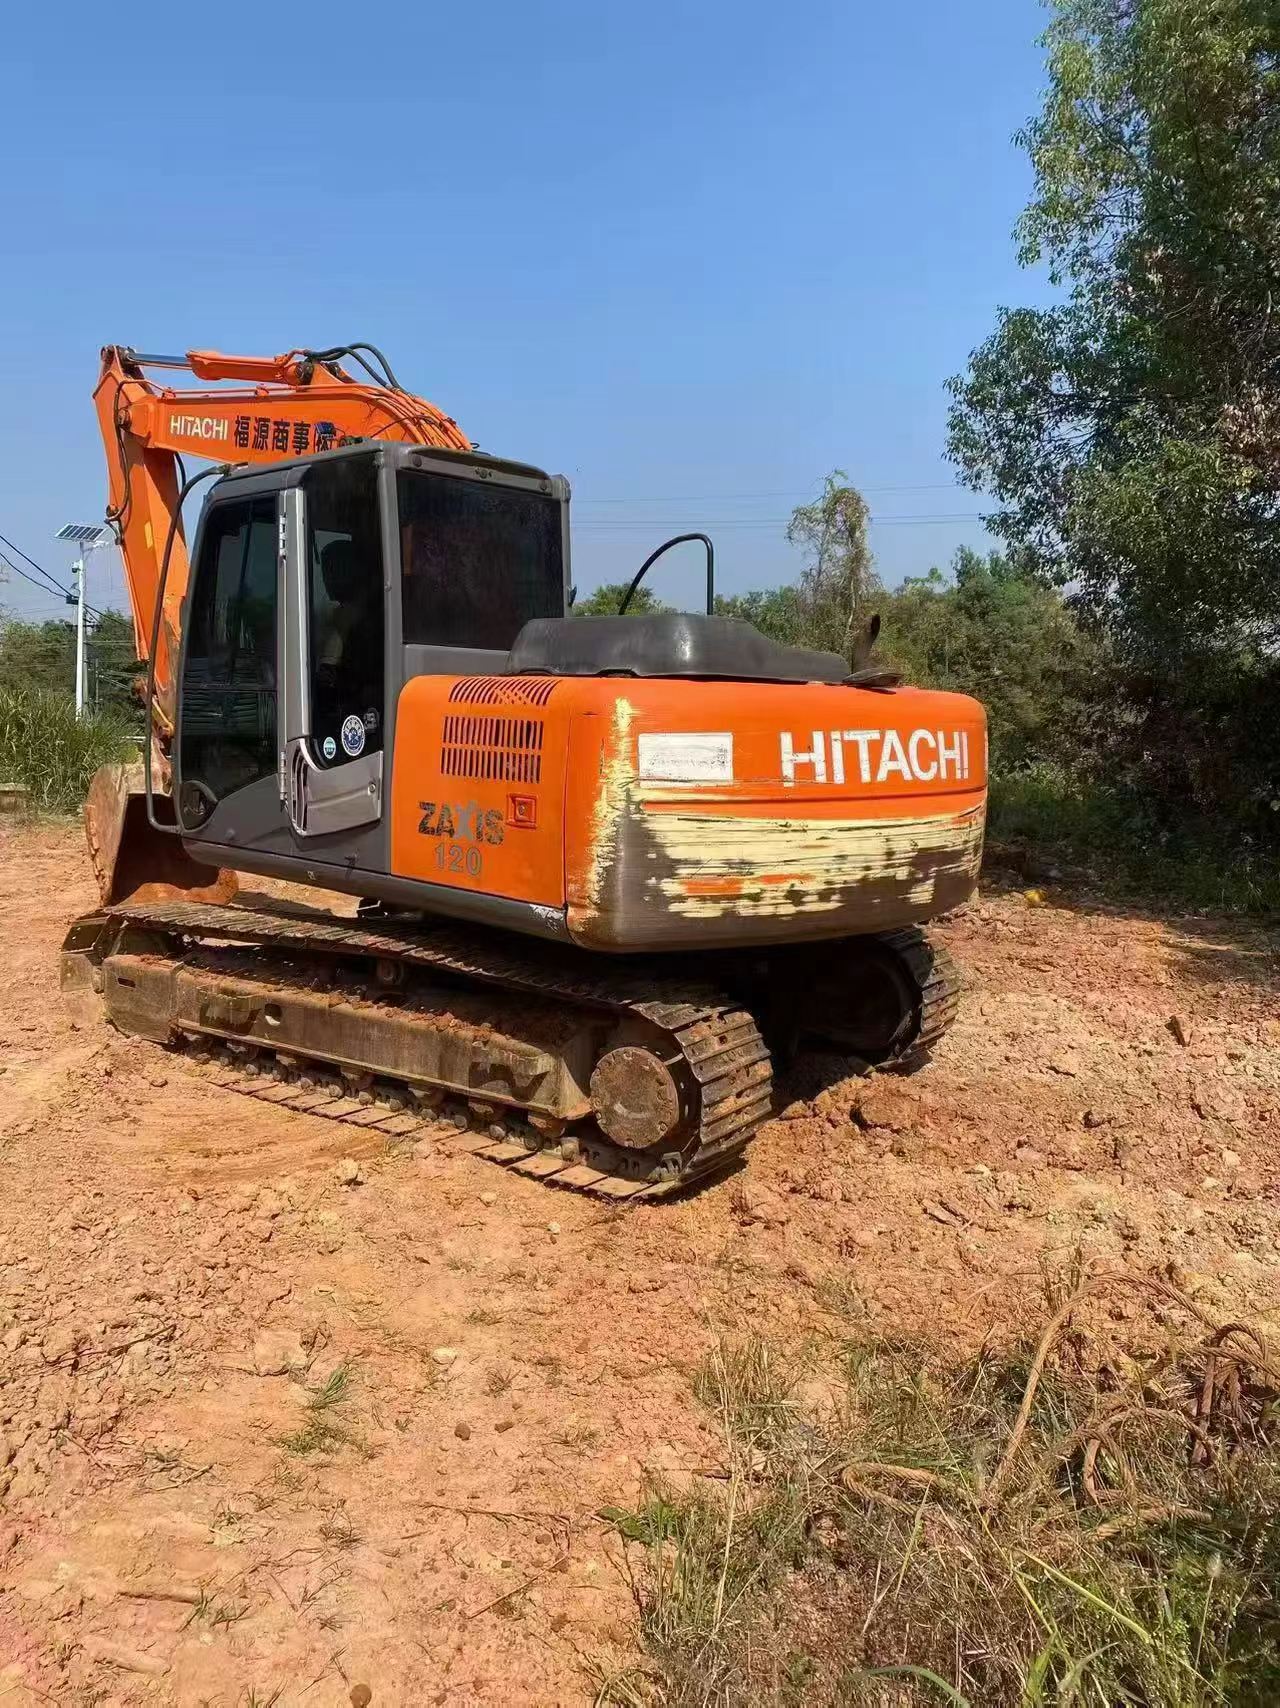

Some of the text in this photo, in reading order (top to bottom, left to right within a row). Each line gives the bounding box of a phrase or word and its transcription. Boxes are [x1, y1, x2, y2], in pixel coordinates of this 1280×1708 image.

[170, 415, 228, 440] HITACHI
[779, 729, 969, 787] HITACHI
[418, 800, 504, 845] ZAXIS
[434, 842, 482, 876] 120
